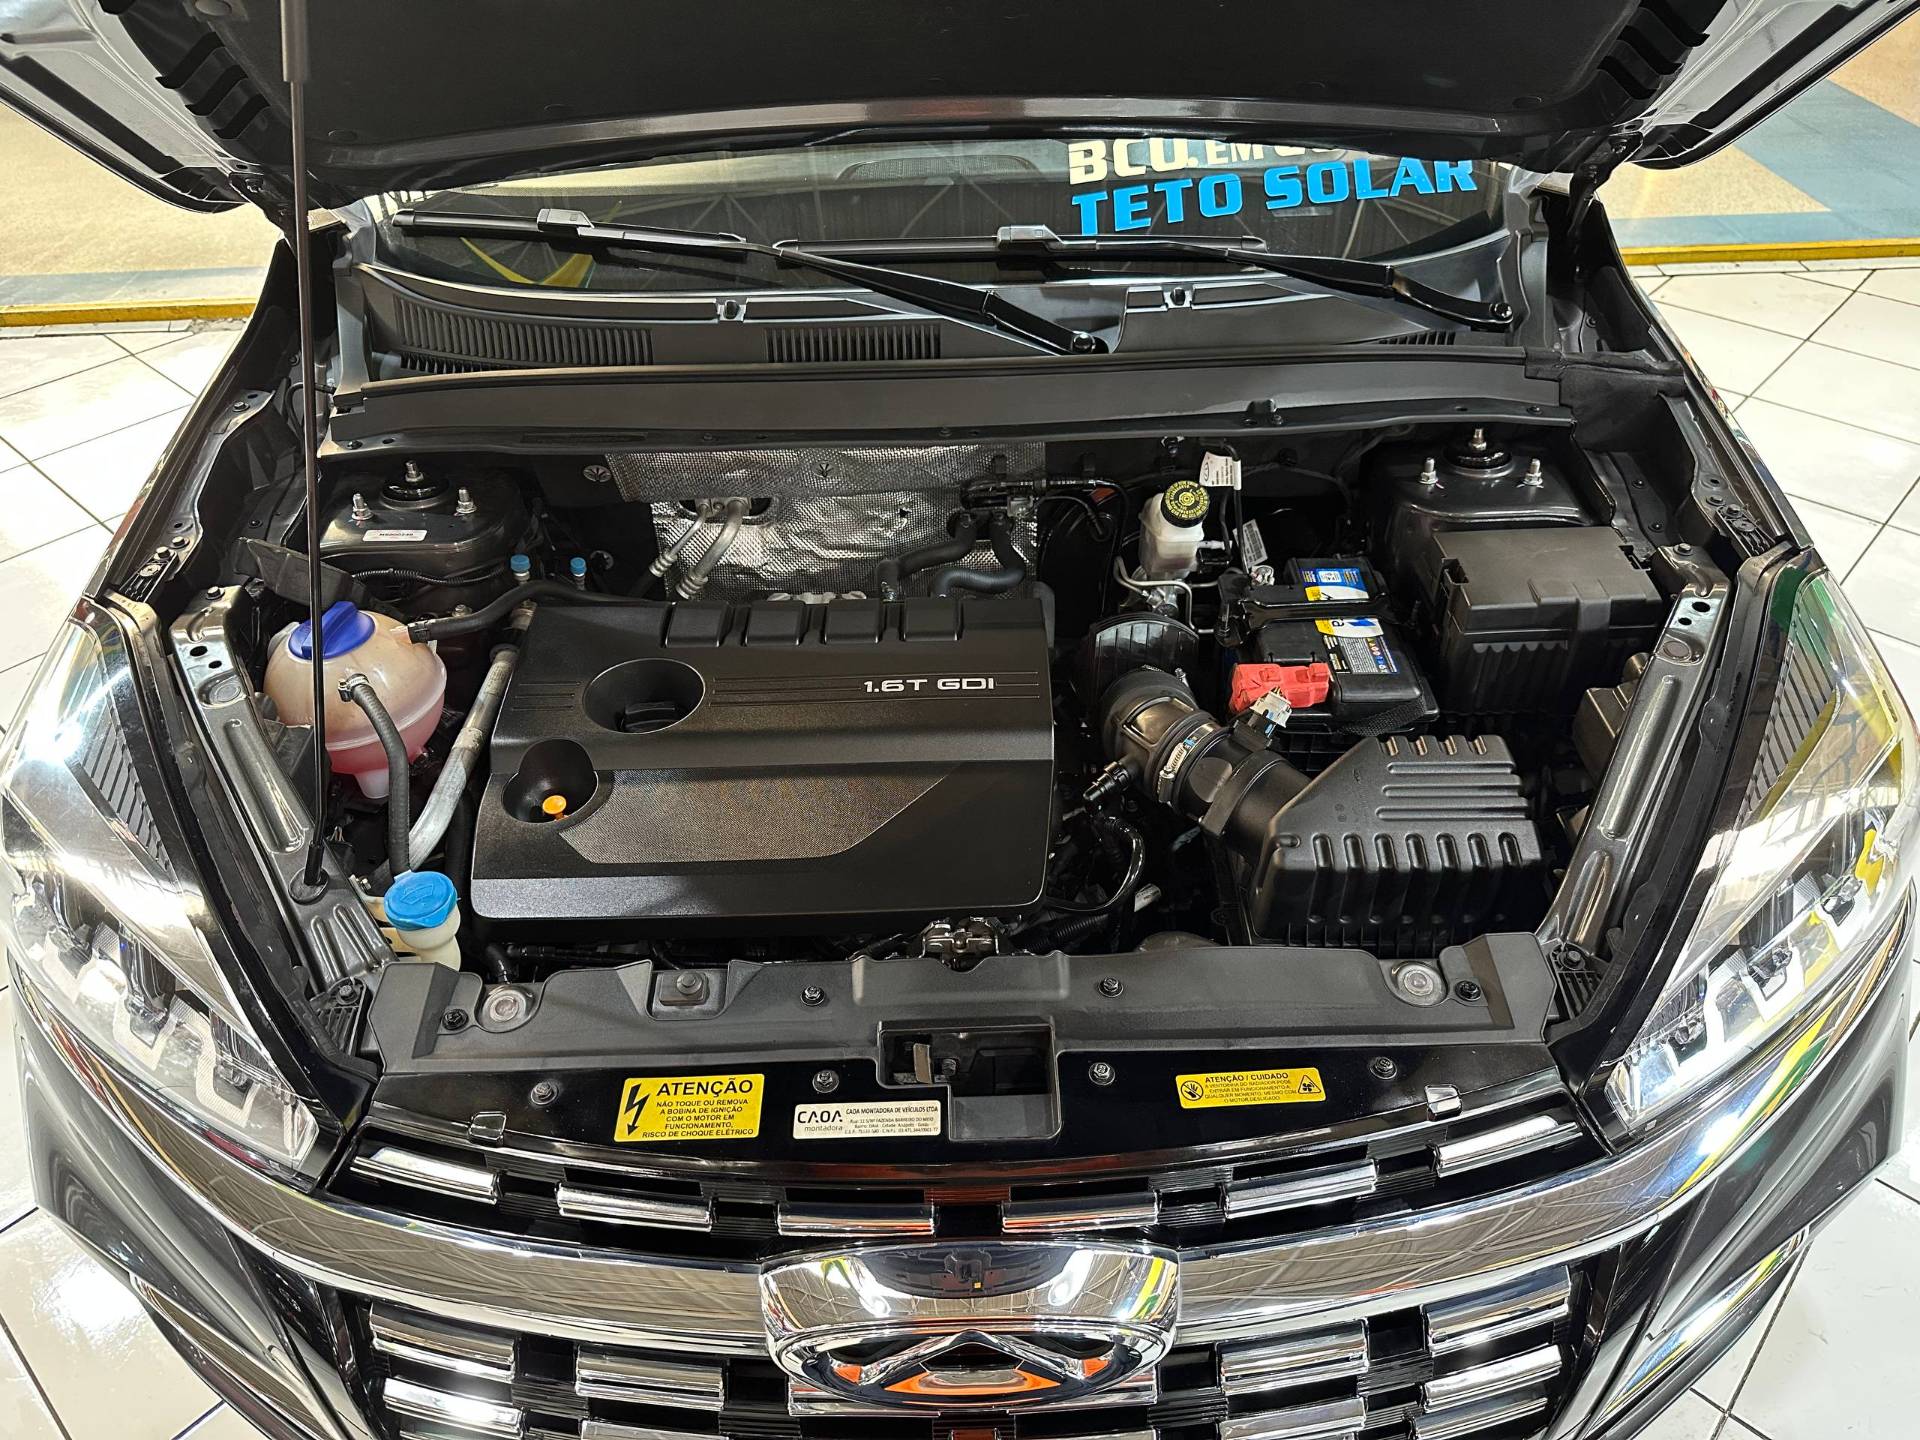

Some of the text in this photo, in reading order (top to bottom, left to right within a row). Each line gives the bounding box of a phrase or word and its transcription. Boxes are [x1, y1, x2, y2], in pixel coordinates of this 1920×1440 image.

[1205, 139, 1264, 164] EM
[1071, 156, 1477, 236] TETO SOLAR
[863, 677, 994, 693] 1.6T GDI
[1205, 1074, 1244, 1083] ATENÇÃO
[1250, 1072, 1289, 1081] CUIDADO
[656, 1077, 753, 1098] ATENÇÃO
[711, 1106, 743, 1114] IGNIÇÃO
[664, 1121, 734, 1130] FUNCIONAMENTO,
[680, 1129, 714, 1137] CHOQUE
[715, 1128, 754, 1136] ELÉTRICO
